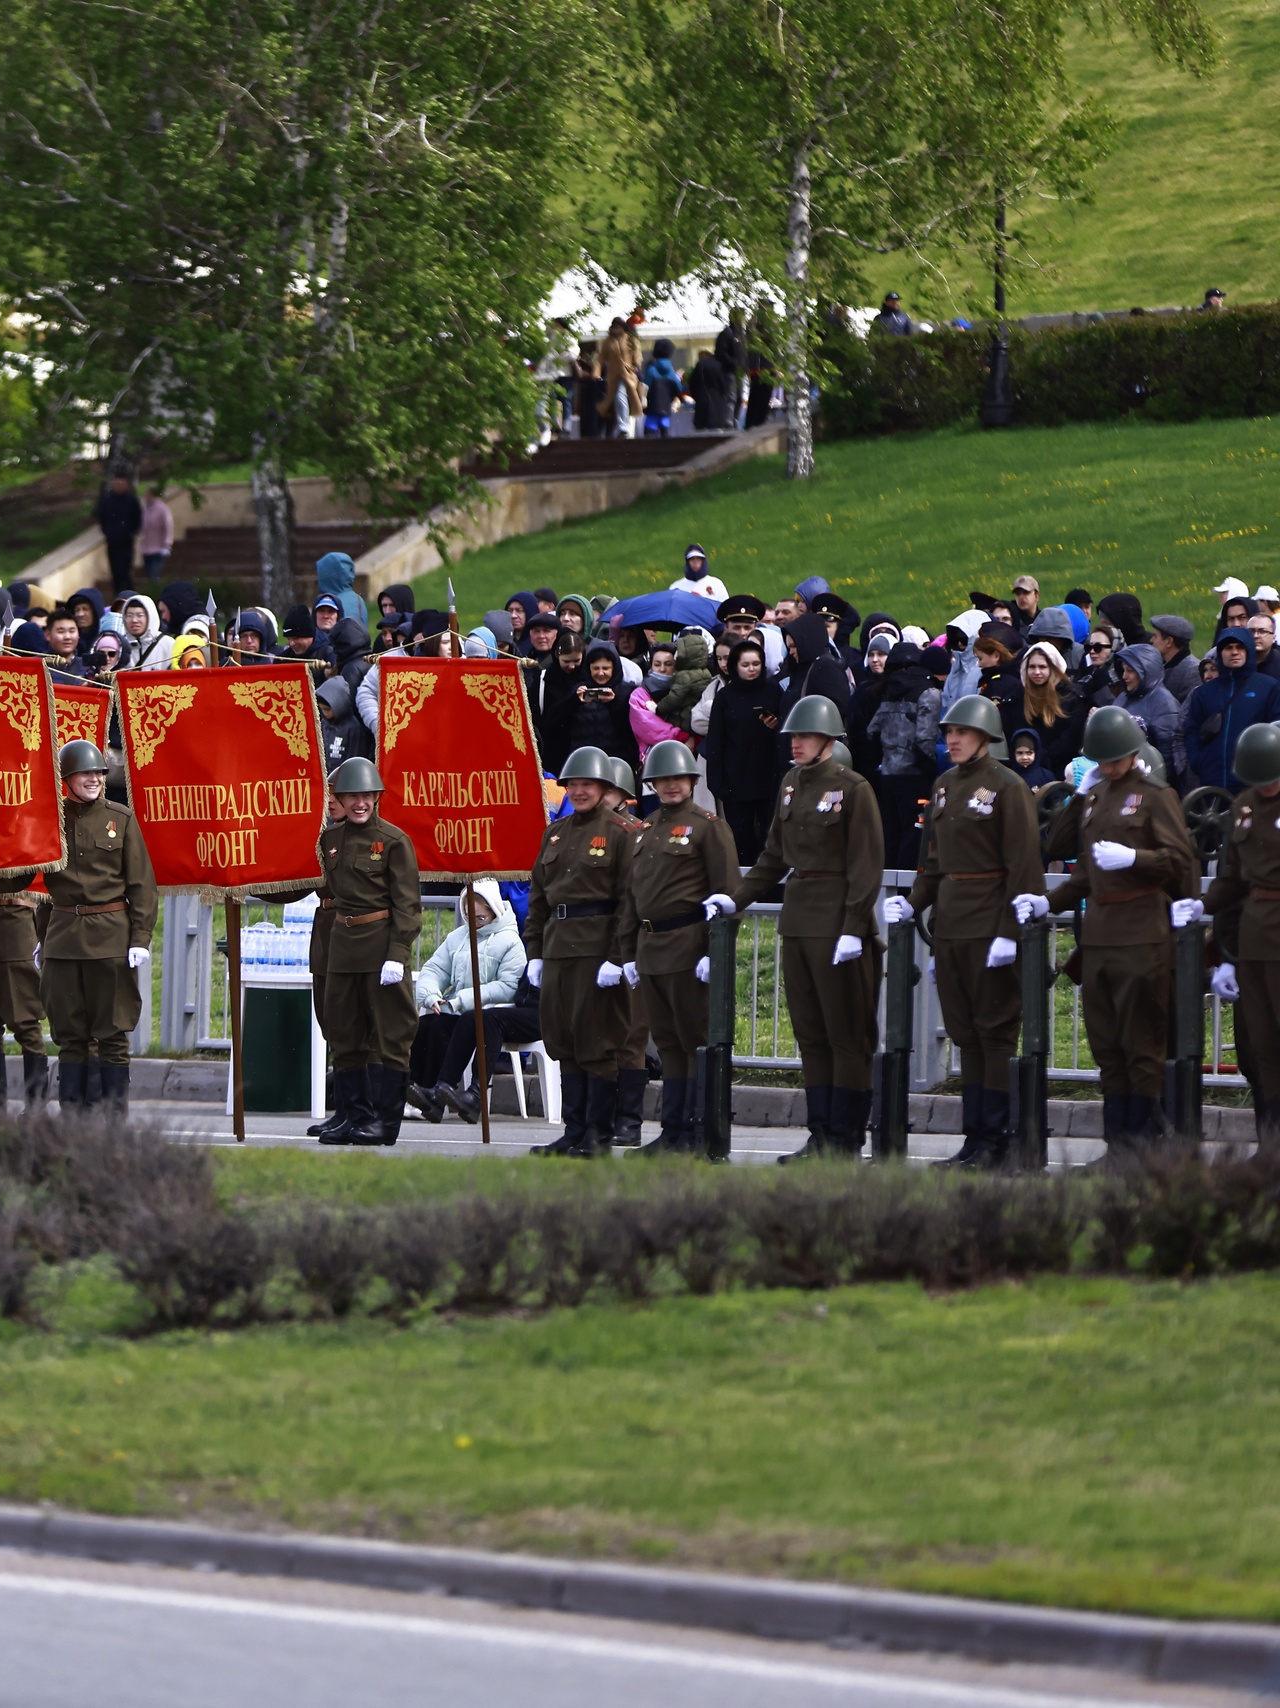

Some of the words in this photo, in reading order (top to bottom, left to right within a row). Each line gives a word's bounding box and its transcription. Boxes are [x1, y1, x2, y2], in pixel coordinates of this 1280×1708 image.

[143, 768, 312, 828] ЛЕНИНГРАДСКИЙ
[402, 761, 520, 808] КАРЕЛЬСКИЙ
[196, 829, 259, 868] ФРОНТ
[434, 817, 494, 855] ФРОНТ
